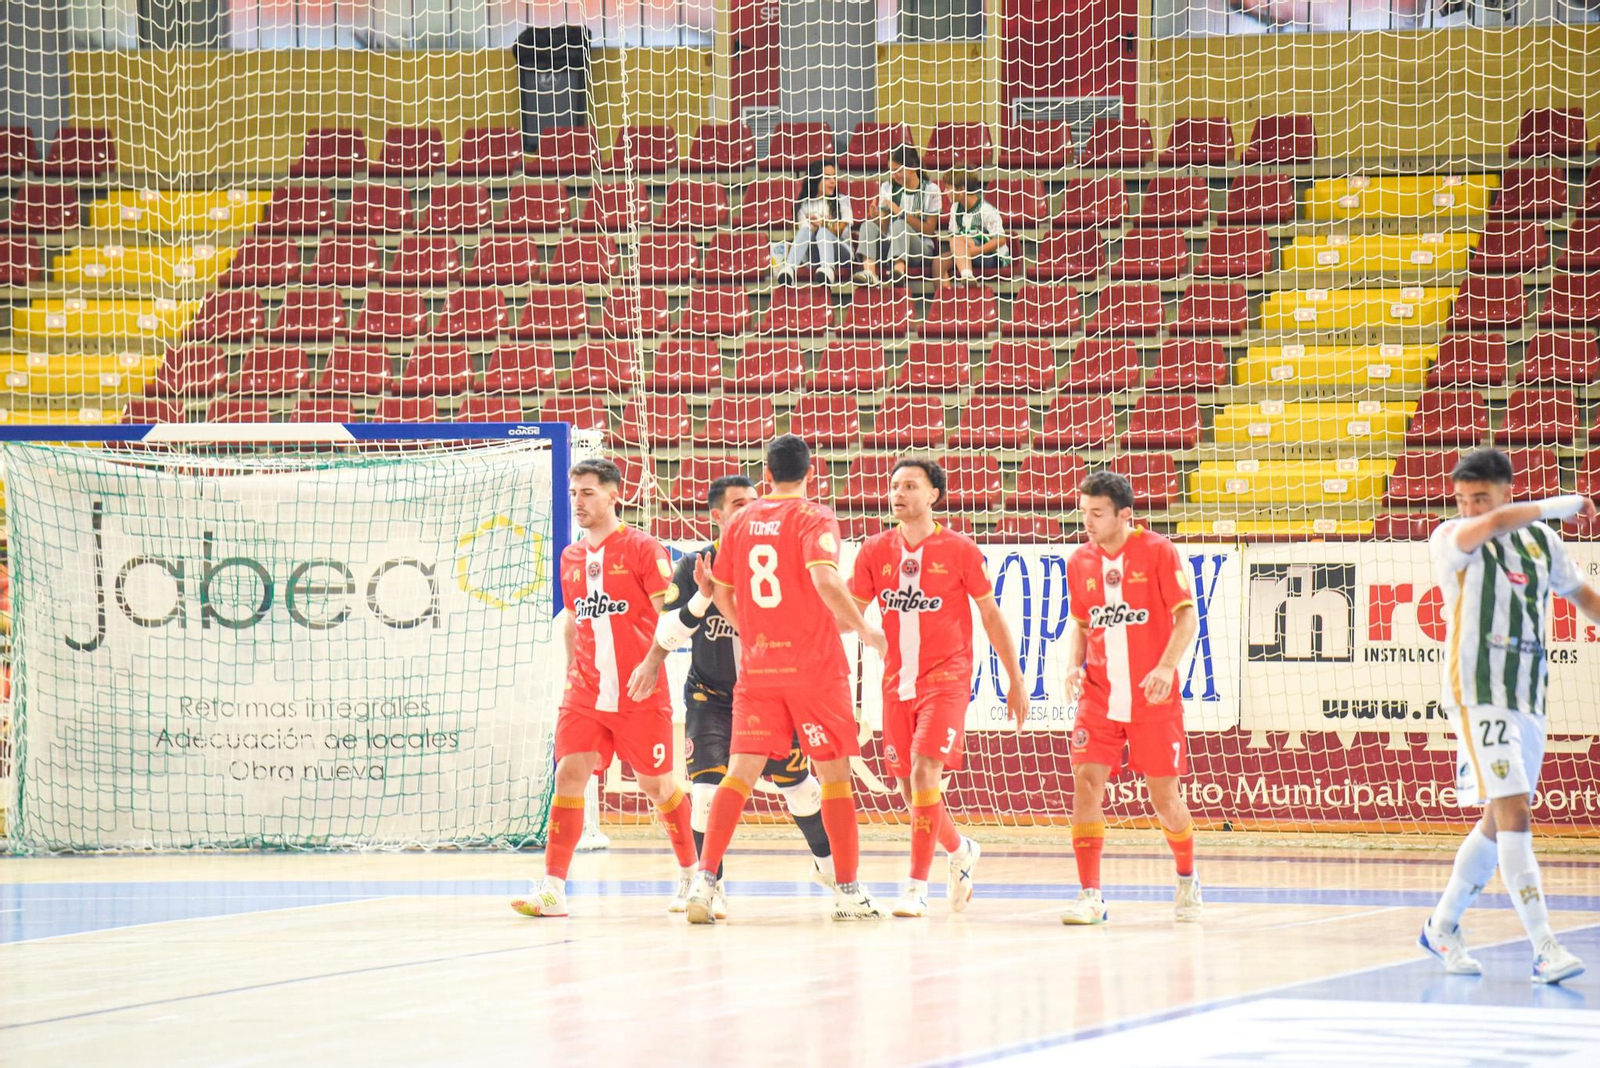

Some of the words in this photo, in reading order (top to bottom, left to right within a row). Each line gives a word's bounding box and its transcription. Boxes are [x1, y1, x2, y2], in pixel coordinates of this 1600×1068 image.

[749, 521, 781, 536] TOMAZ
[749, 544, 782, 608] 8
[882, 584, 940, 613] Jimbee
[305, 697, 431, 722] integrales
[156, 728, 315, 750] Adecuación
[366, 728, 459, 750] locales
[940, 727, 956, 754] 3
[1479, 720, 1509, 747] 22
[653, 743, 666, 768] 9
[1172, 742, 1181, 768] 7
[229, 760, 294, 781] Obra
[303, 763, 385, 781] nueva
[1234, 777, 1404, 813] Municipal
[1415, 779, 1457, 808] de
